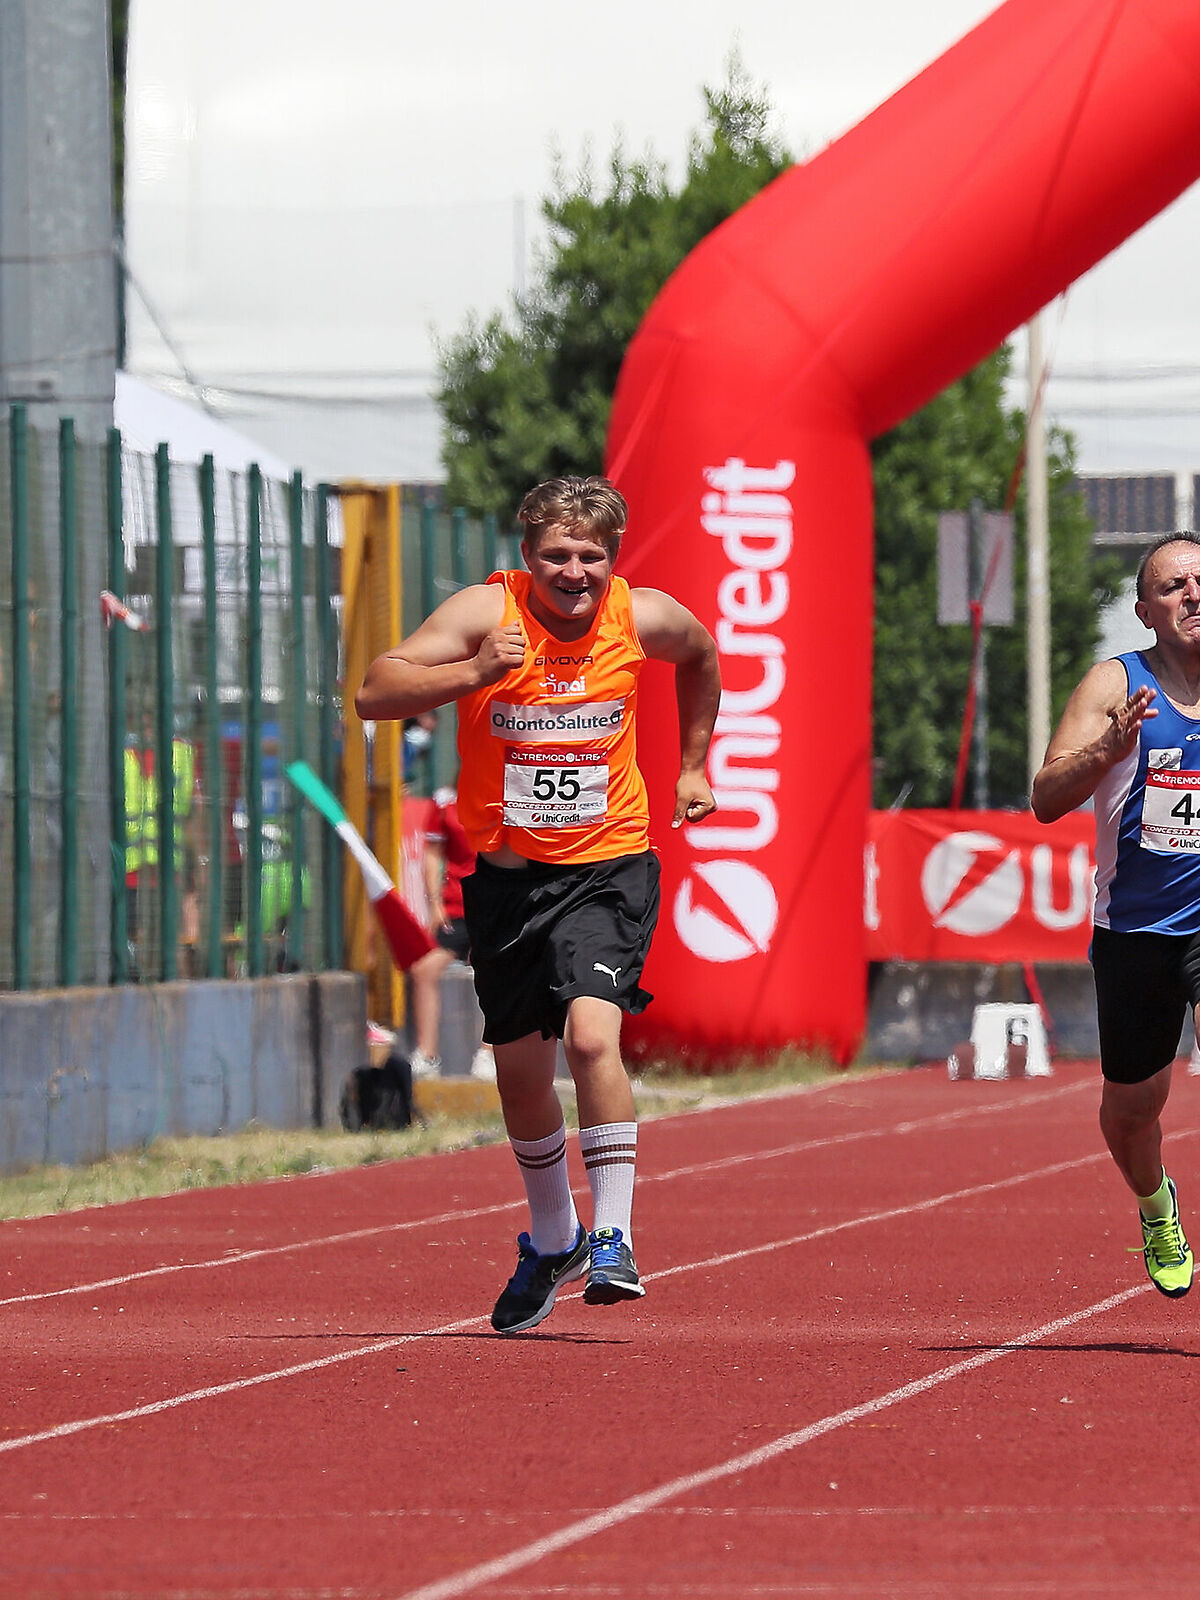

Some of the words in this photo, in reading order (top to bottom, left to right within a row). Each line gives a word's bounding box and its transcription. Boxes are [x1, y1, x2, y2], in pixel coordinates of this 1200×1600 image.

[685, 457, 797, 851] UniCredit
[534, 655, 594, 667] GIVOVA
[492, 712, 608, 731] OdontoSalute
[511, 752, 601, 763] OLTREMODOLTRE
[532, 769, 581, 801] 55
[507, 801, 552, 811] CONCESIO
[541, 813, 581, 823] UniCredit
[1144, 825, 1191, 836] CONCESIO
